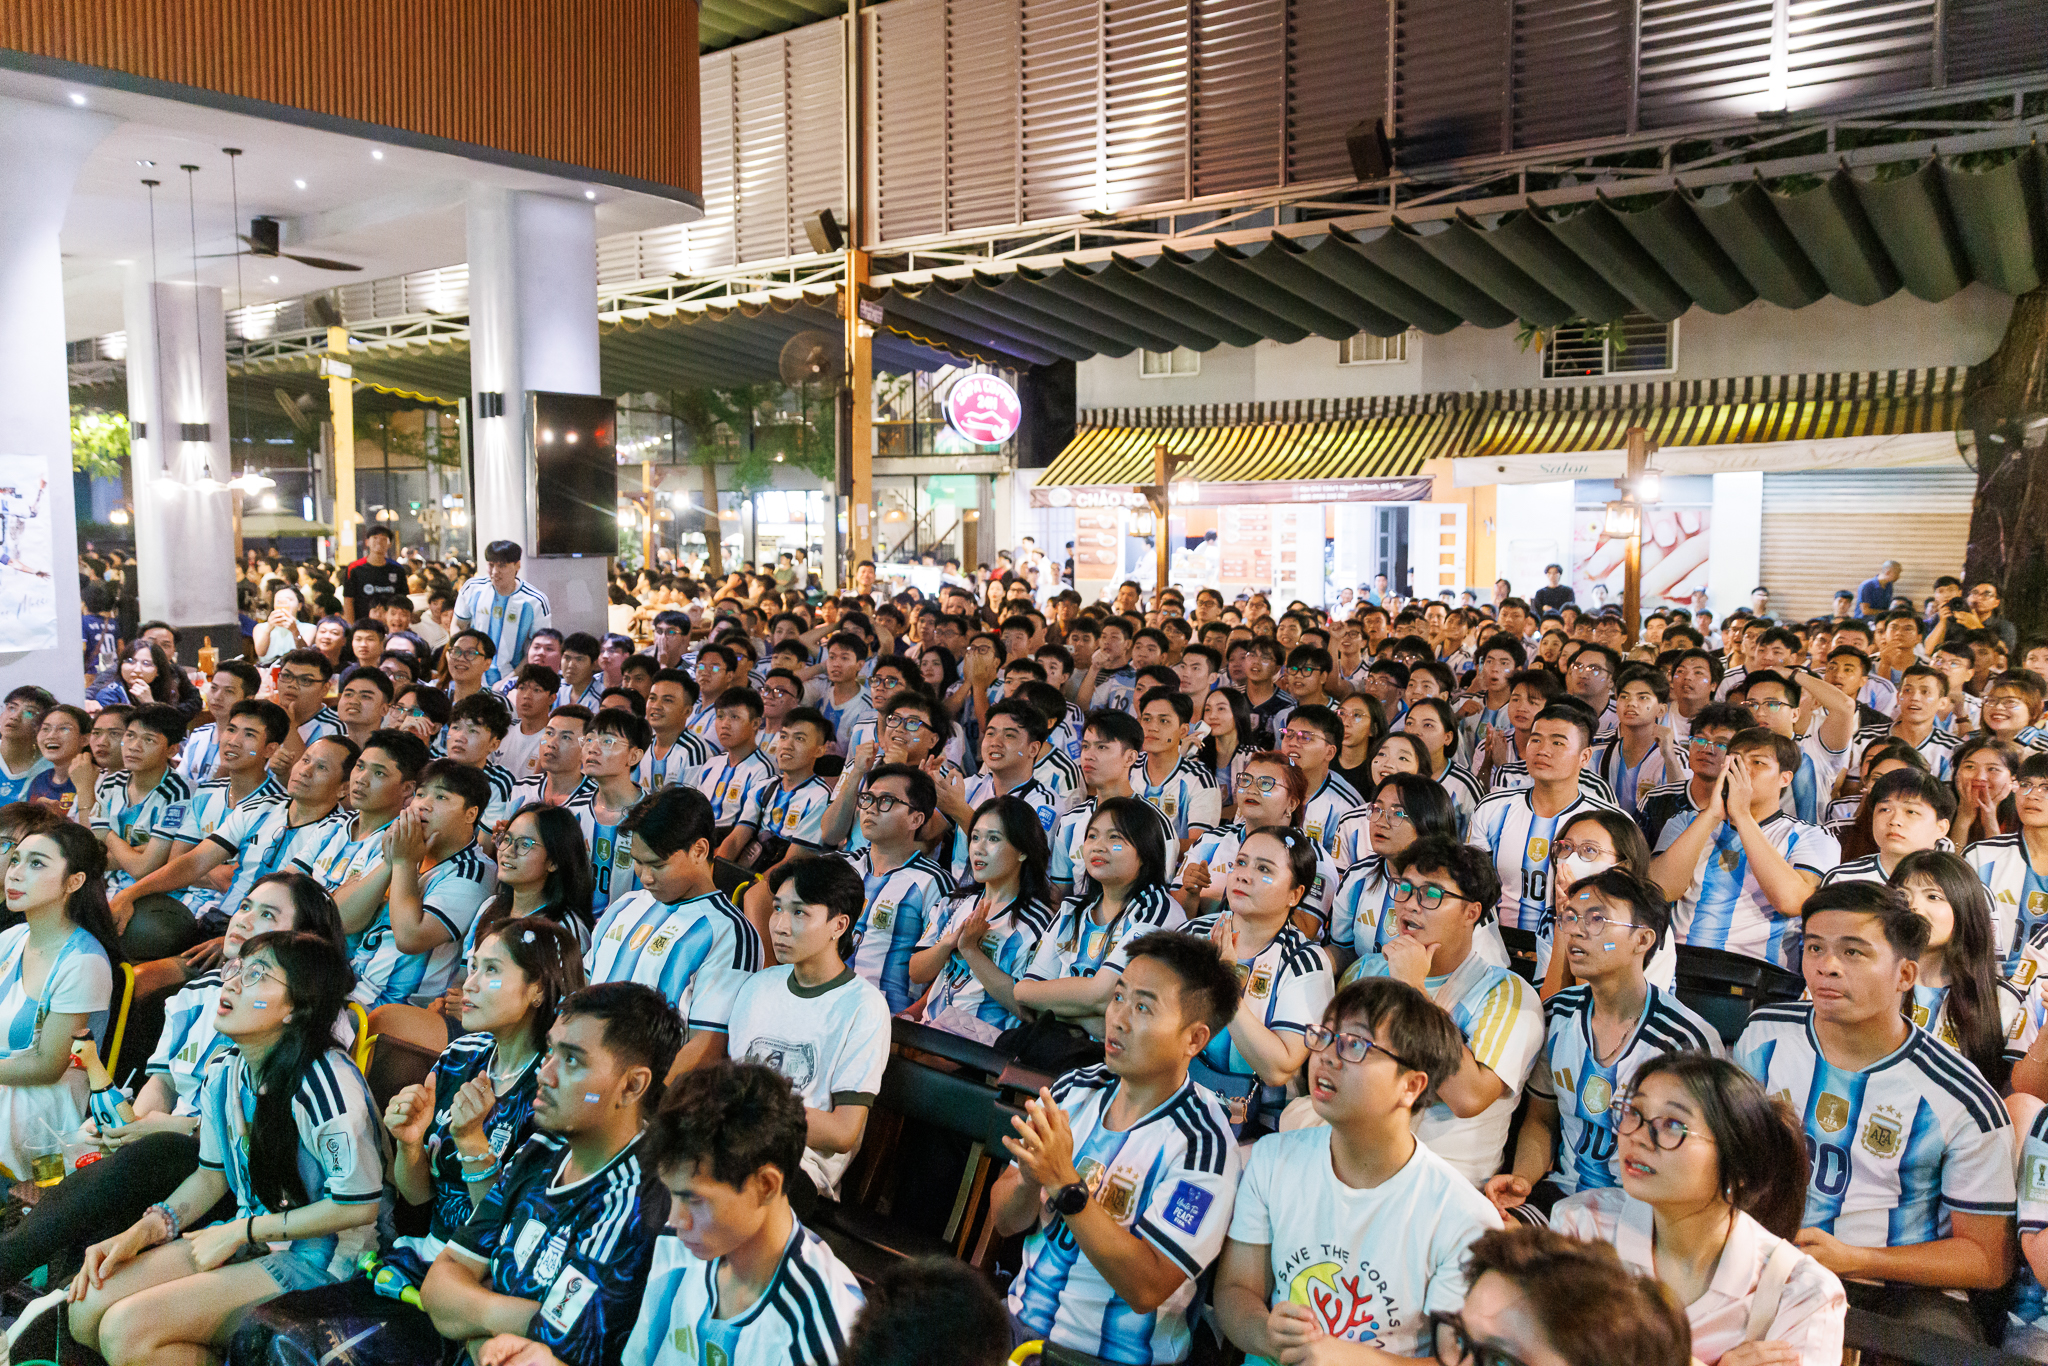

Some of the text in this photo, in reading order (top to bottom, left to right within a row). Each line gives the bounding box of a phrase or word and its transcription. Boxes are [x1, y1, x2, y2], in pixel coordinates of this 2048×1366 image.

[956, 380, 982, 406] SAPA
[977, 394, 998, 411] 24H
[1540, 462, 1588, 473] Salon
[1076, 489, 1121, 507] CHÁO
[1521, 868, 1548, 901] 10
[93, 1111, 112, 1125] 10
[1823, 1116, 1838, 1126] FIFA
[1870, 1124, 1892, 1147] AFA
[1172, 1206, 1195, 1226] PEACE
[1173, 1216, 1186, 1228] FIFA
[1278, 1243, 1401, 1328] SAVE THE CORALS
